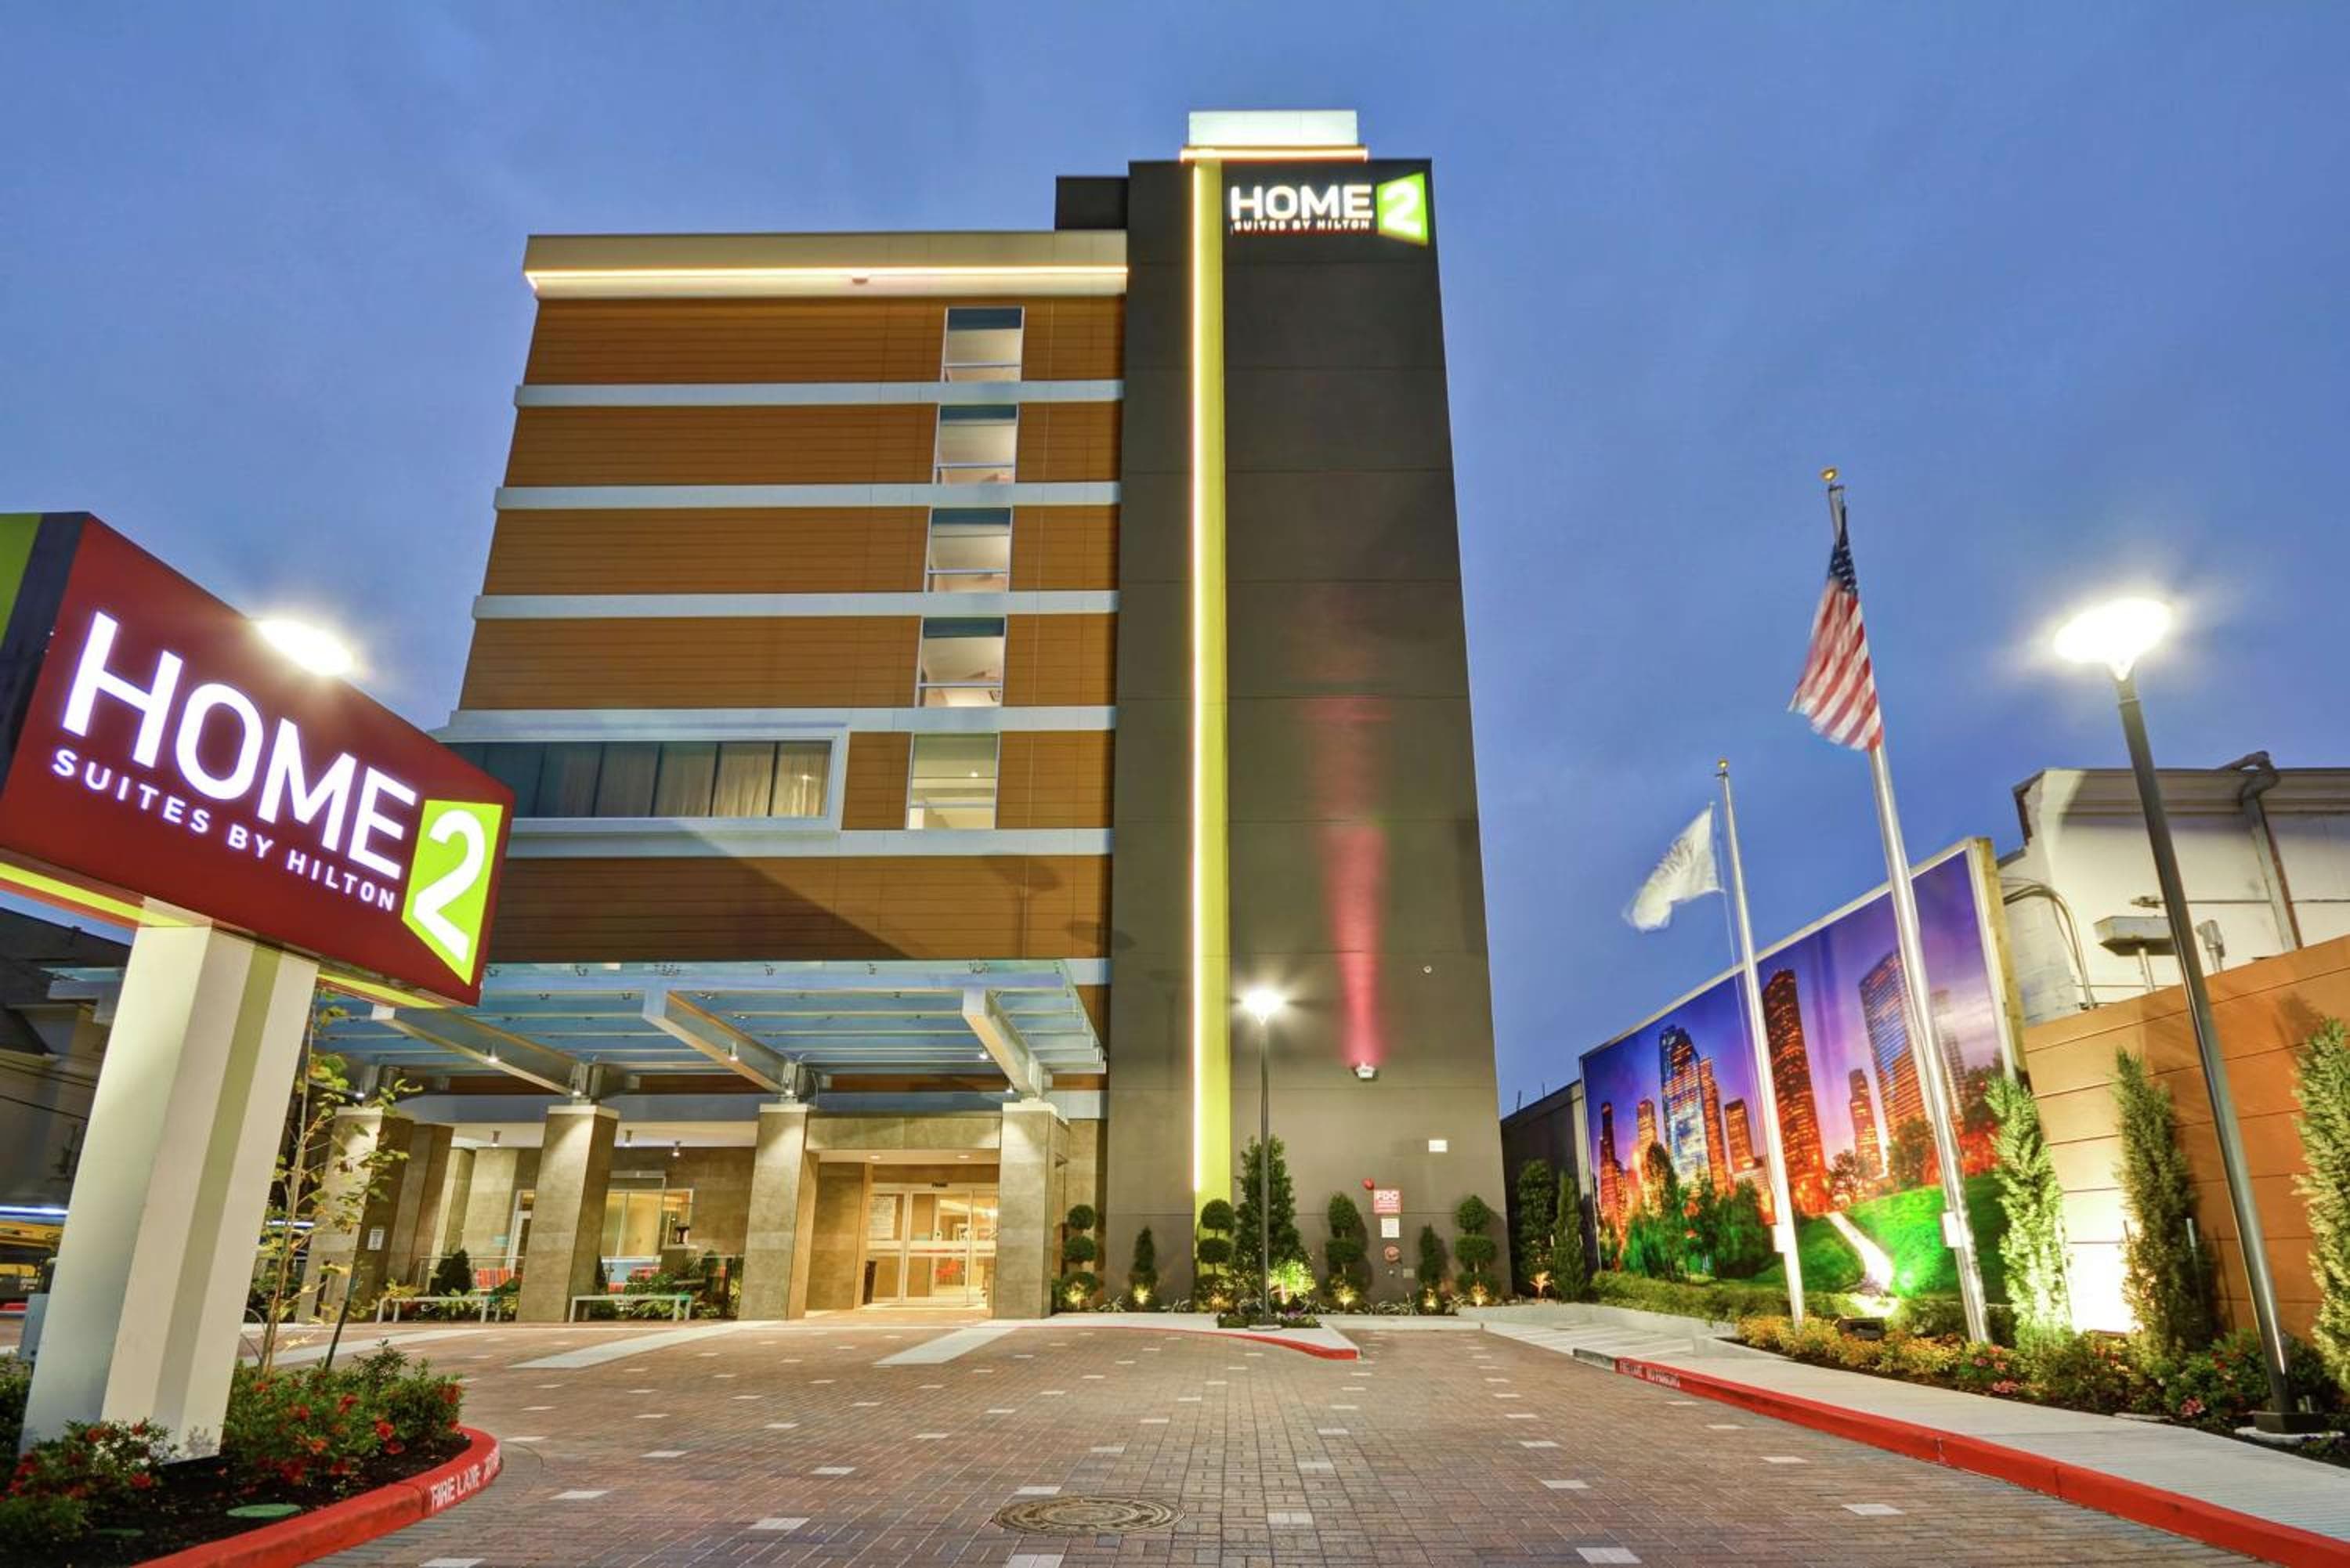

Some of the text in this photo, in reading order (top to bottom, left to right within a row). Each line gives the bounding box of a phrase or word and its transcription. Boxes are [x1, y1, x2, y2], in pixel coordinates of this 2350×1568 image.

[1230, 180, 1422, 236] HOME 2
[1234, 219, 1370, 231] SUITES BY HILTON
[62, 610, 486, 963] HOME 2
[52, 748, 396, 912] SUITES BY HILTON
[431, 1476, 455, 1512] FIRE
